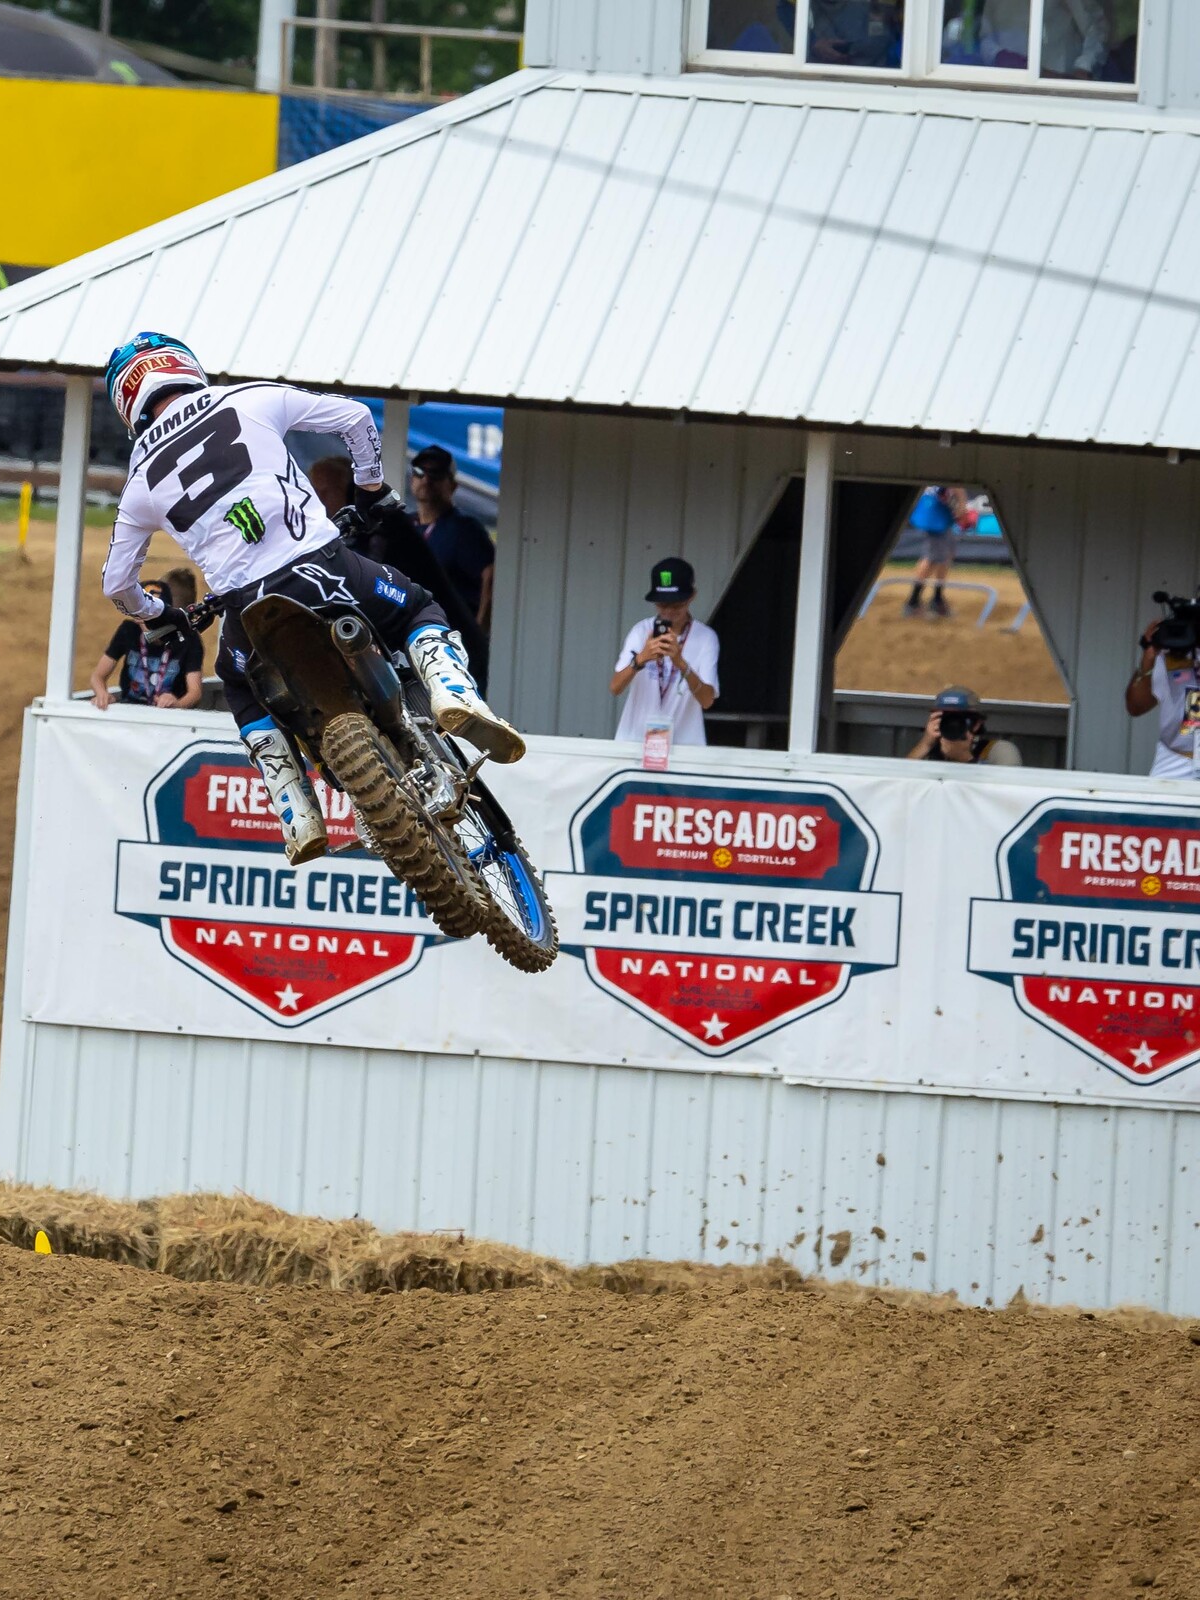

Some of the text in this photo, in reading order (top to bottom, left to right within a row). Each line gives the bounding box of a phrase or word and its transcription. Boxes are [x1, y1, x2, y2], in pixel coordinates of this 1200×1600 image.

[125, 356, 172, 391] TOMAC
[138, 393, 212, 455] TOMAC
[146, 406, 253, 533] 3
[633, 803, 818, 852] FRESCADOS
[656, 848, 797, 866] PREMIUM TORTILLAS
[1060, 831, 1200, 877] FRESCAD
[158, 860, 297, 909] SPRING
[1084, 875, 1137, 888] PREMIUM
[196, 927, 388, 957] NATIONAL
[583, 890, 857, 948] SPRING CREEK
[1012, 918, 1152, 967] SPRING
[621, 957, 816, 985] NATIONAL
[1049, 985, 1194, 1010] NATION
